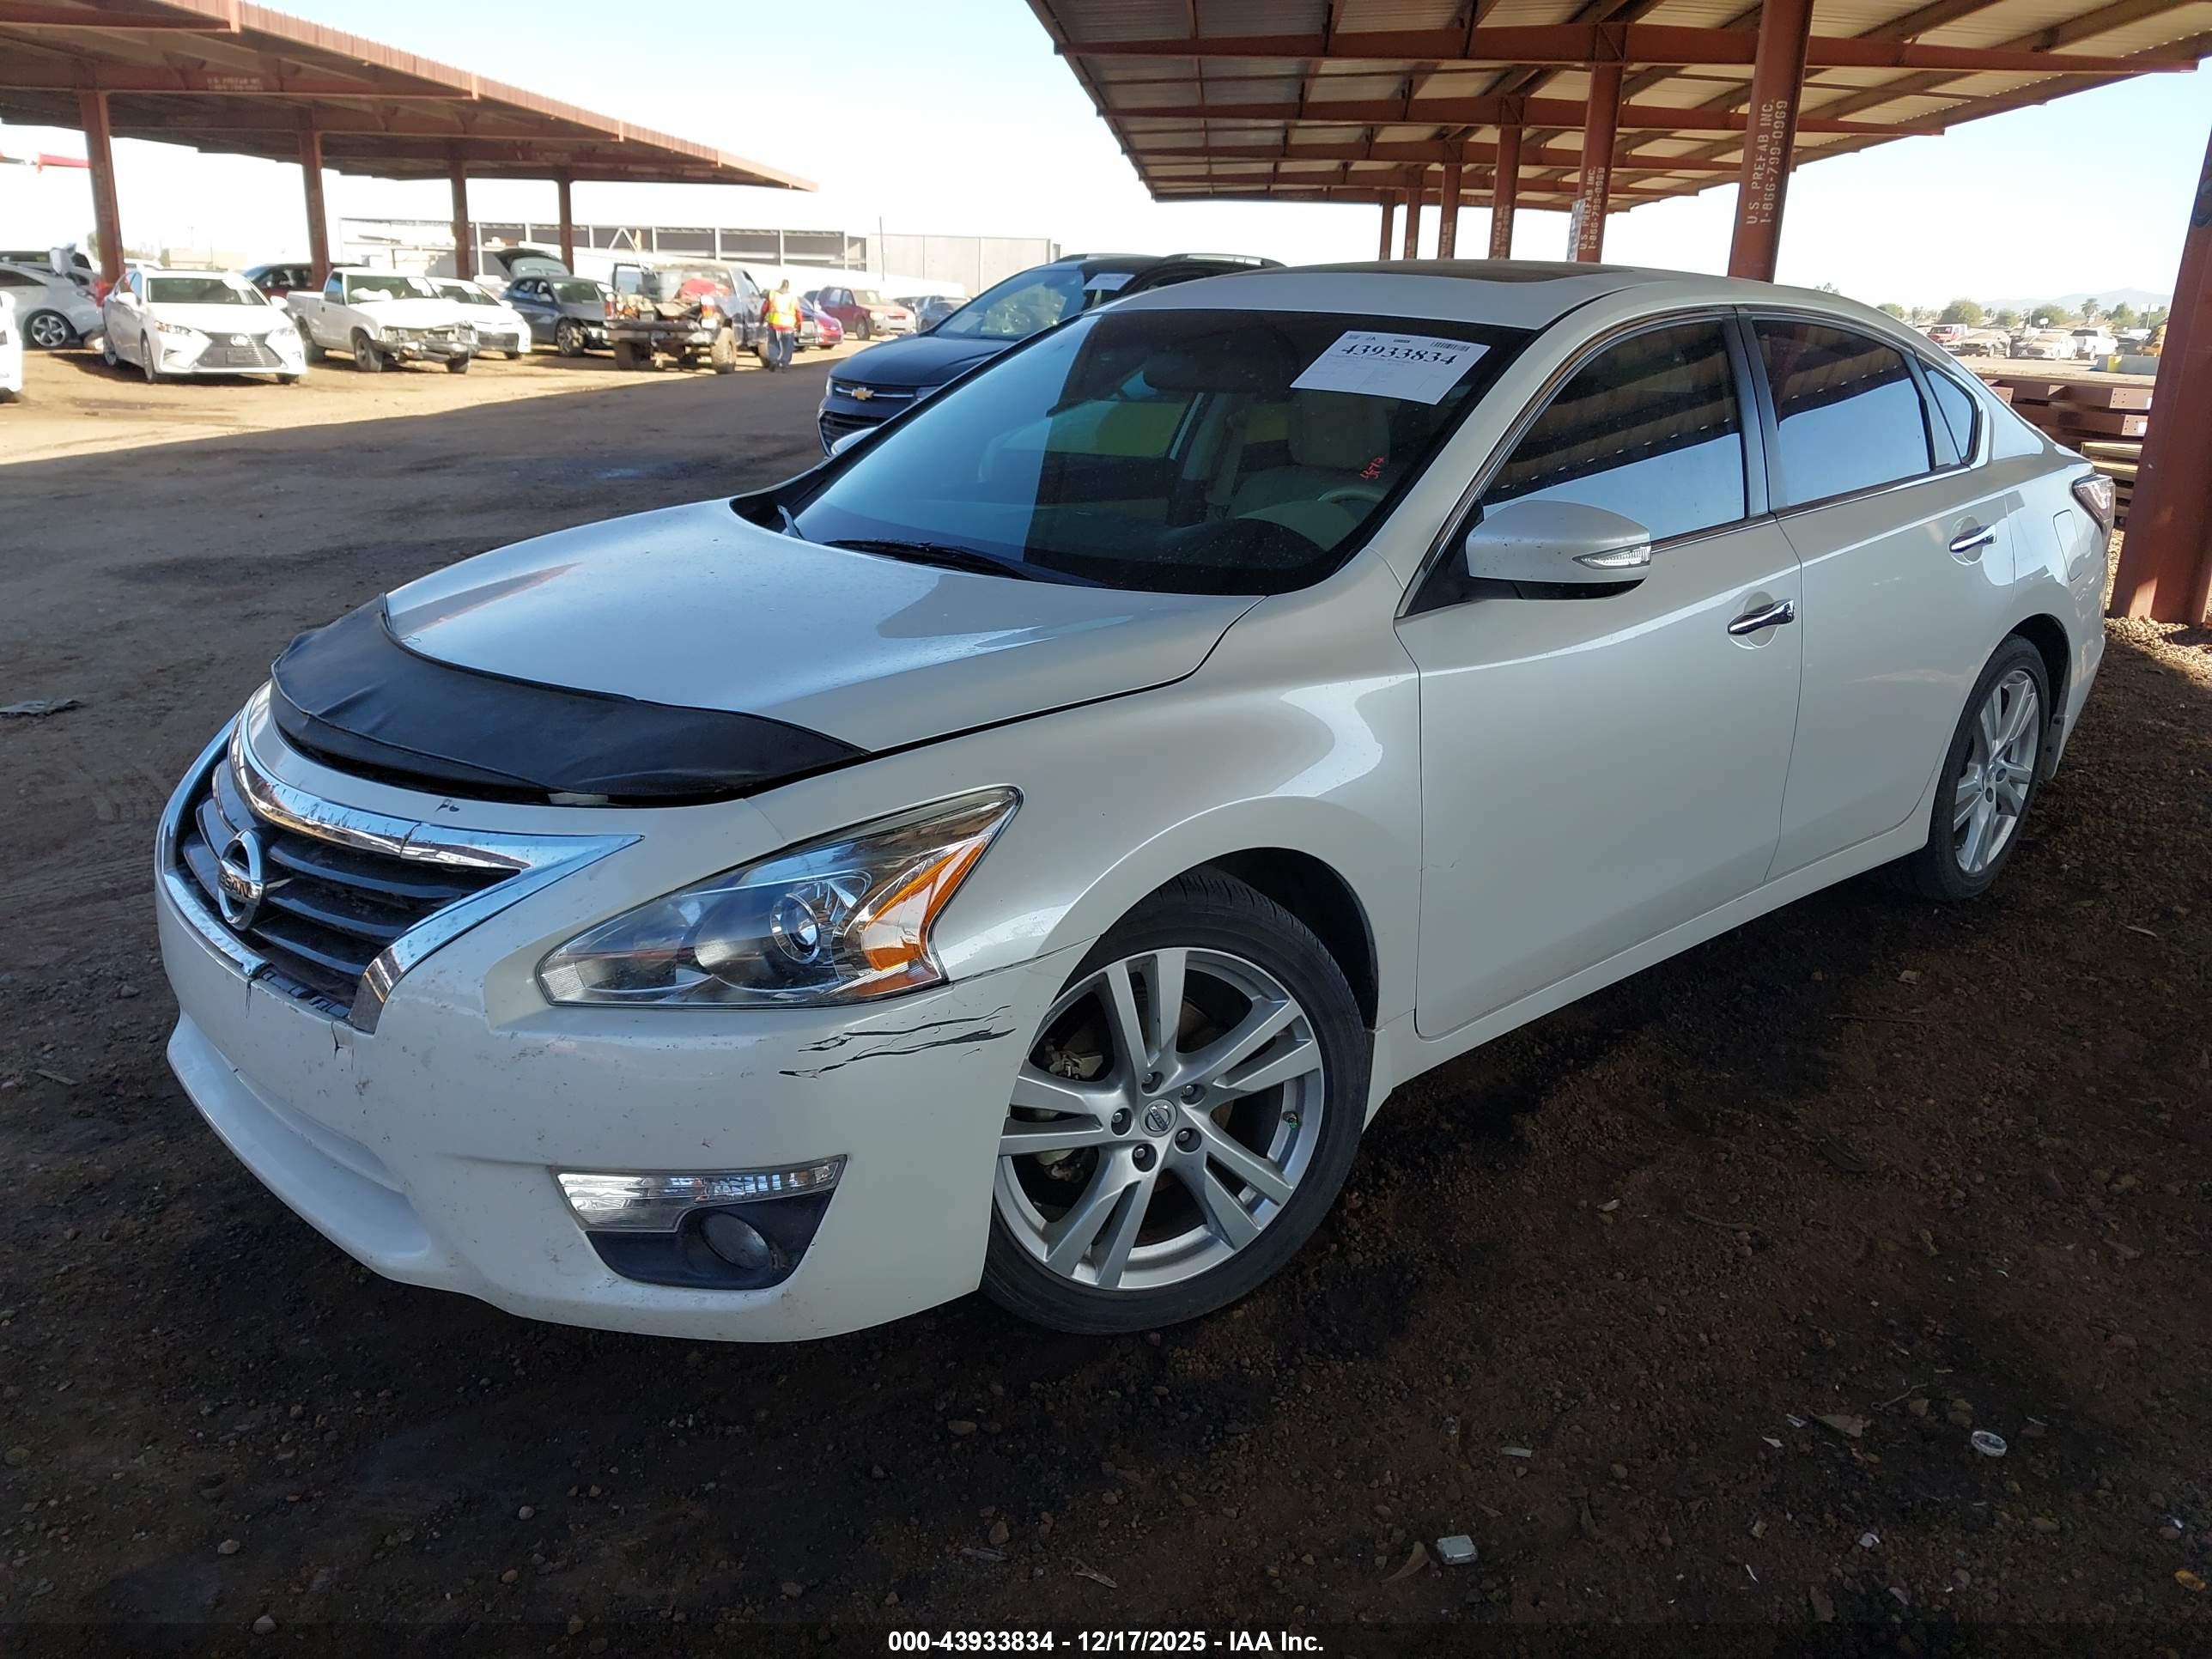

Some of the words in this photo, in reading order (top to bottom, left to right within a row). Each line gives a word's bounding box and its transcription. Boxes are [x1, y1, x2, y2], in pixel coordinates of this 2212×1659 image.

[1760, 98, 1775, 127] INC.
[1751, 133, 1770, 190] PREFAB
[1760, 100, 1788, 224] 1-866-799-0969
[1341, 343, 1458, 366] 43933834
